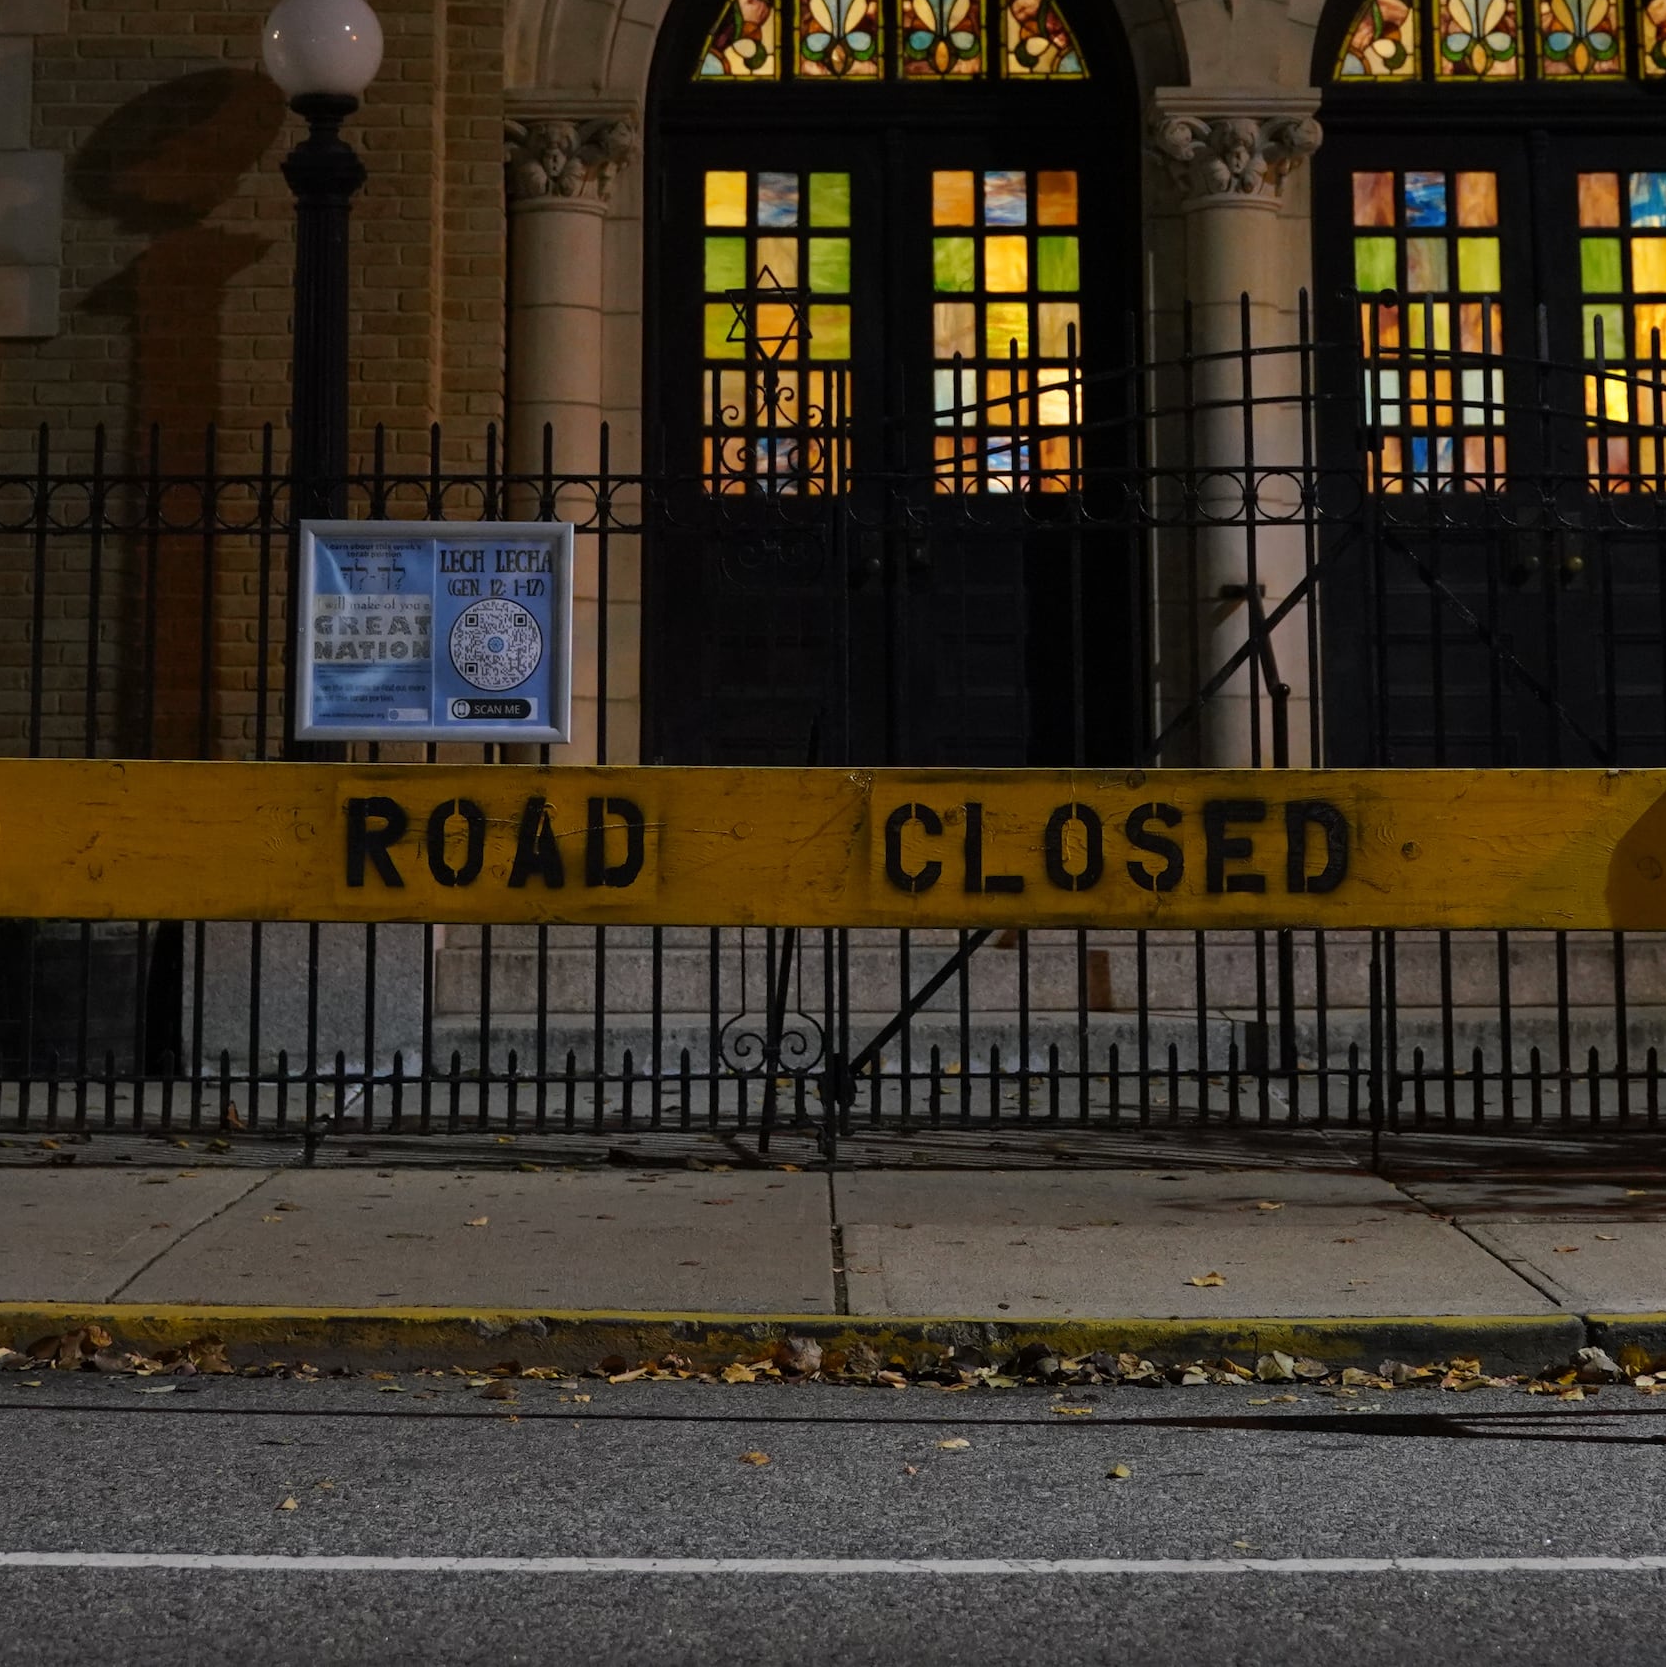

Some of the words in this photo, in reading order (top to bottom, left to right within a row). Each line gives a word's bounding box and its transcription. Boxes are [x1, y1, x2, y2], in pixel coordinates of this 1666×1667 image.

[440, 550, 485, 573] LECH
[495, 550, 552, 573] LECHA
[490, 579, 507, 597] 12:
[324, 596, 345, 610] will
[350, 596, 380, 610] make
[384, 597, 395, 610] of
[399, 602, 421, 613] you
[313, 615, 432, 635] GREAT
[313, 640, 431, 660] NATION
[474, 704, 502, 715] SCAN
[505, 704, 520, 715] ME
[344, 795, 647, 890] ROAD
[883, 799, 1353, 894] CLOSED
